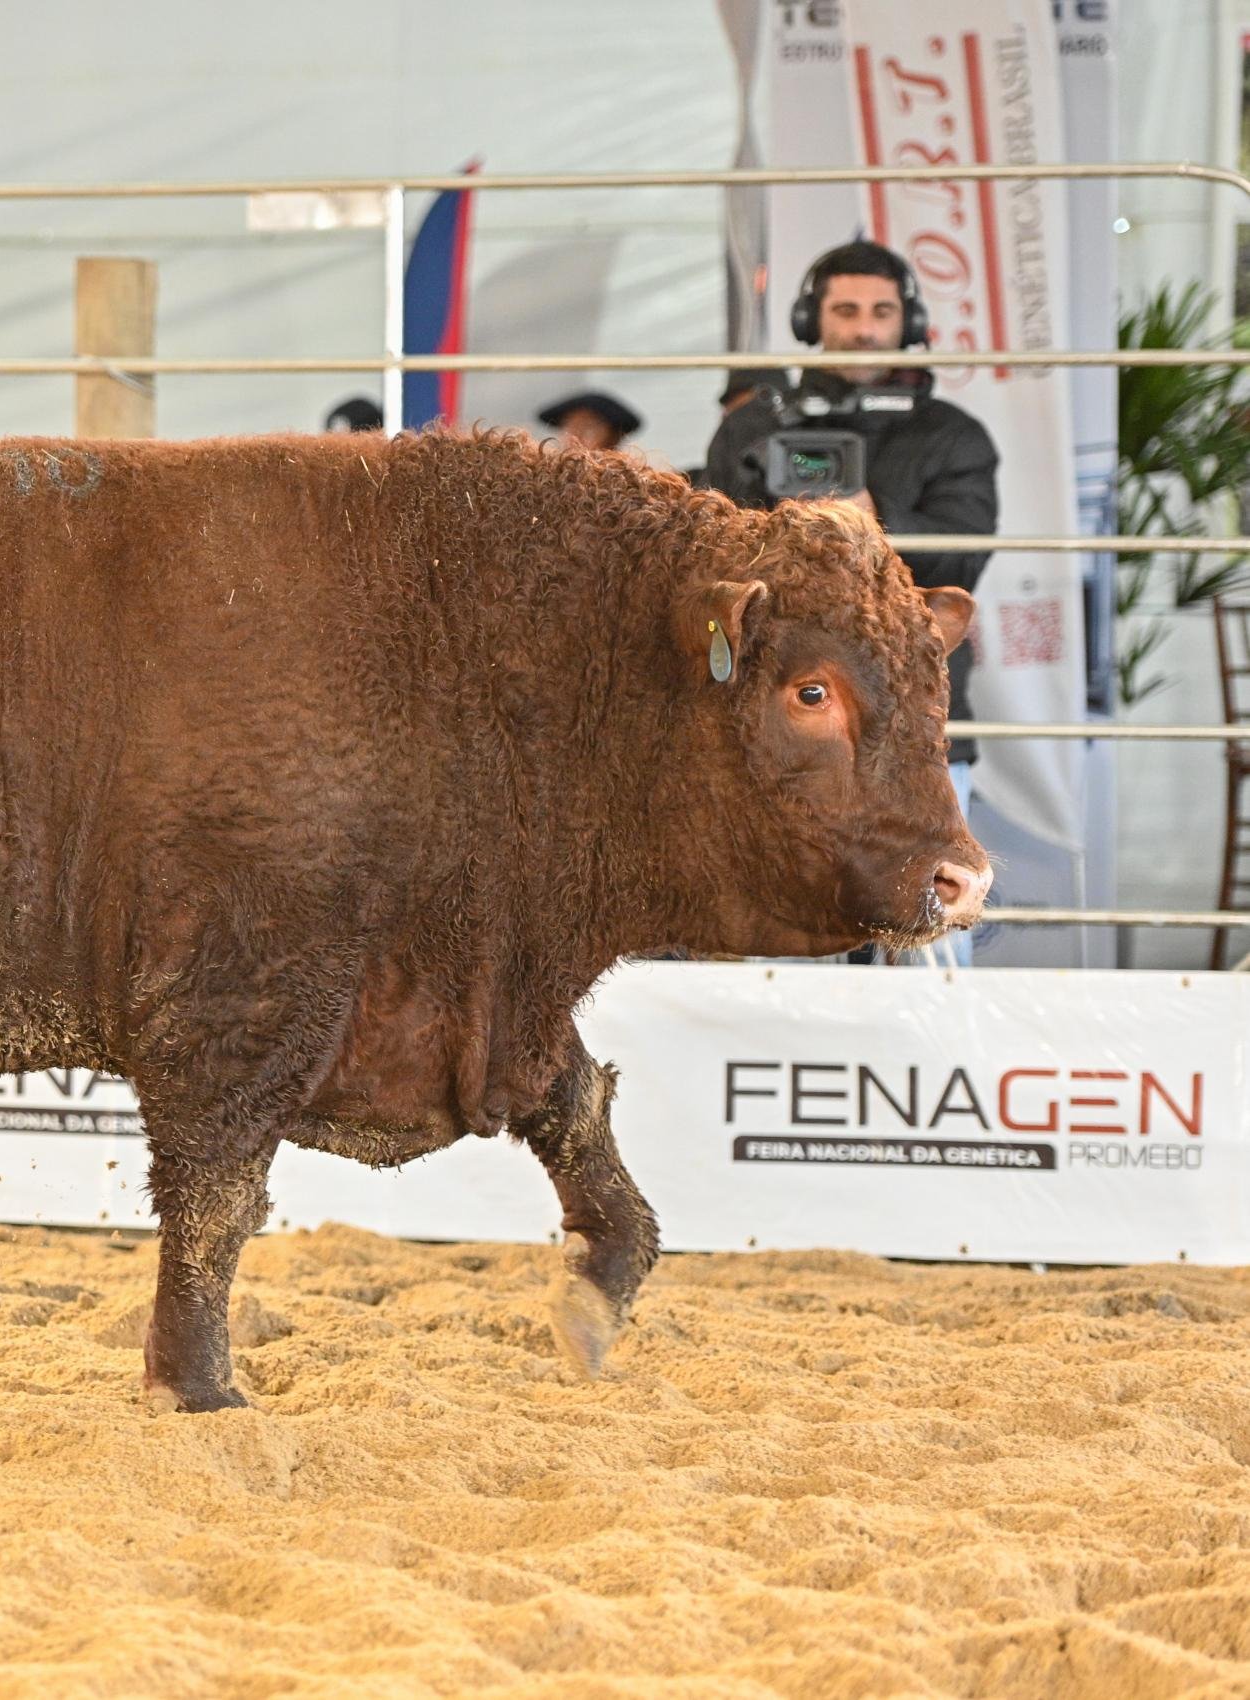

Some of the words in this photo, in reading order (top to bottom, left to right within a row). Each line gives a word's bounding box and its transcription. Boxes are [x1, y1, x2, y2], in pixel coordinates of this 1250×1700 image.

[724, 1060, 1203, 1137] FENAGEN
[65, 1114, 95, 1132] DA
[746, 1140, 805, 1160] FEIRA
[807, 1142, 908, 1163] NACIONAL
[911, 1146, 943, 1164] DA
[944, 1144, 1042, 1167] GENÉTICA
[1068, 1141, 1202, 1170] PROMEBO
